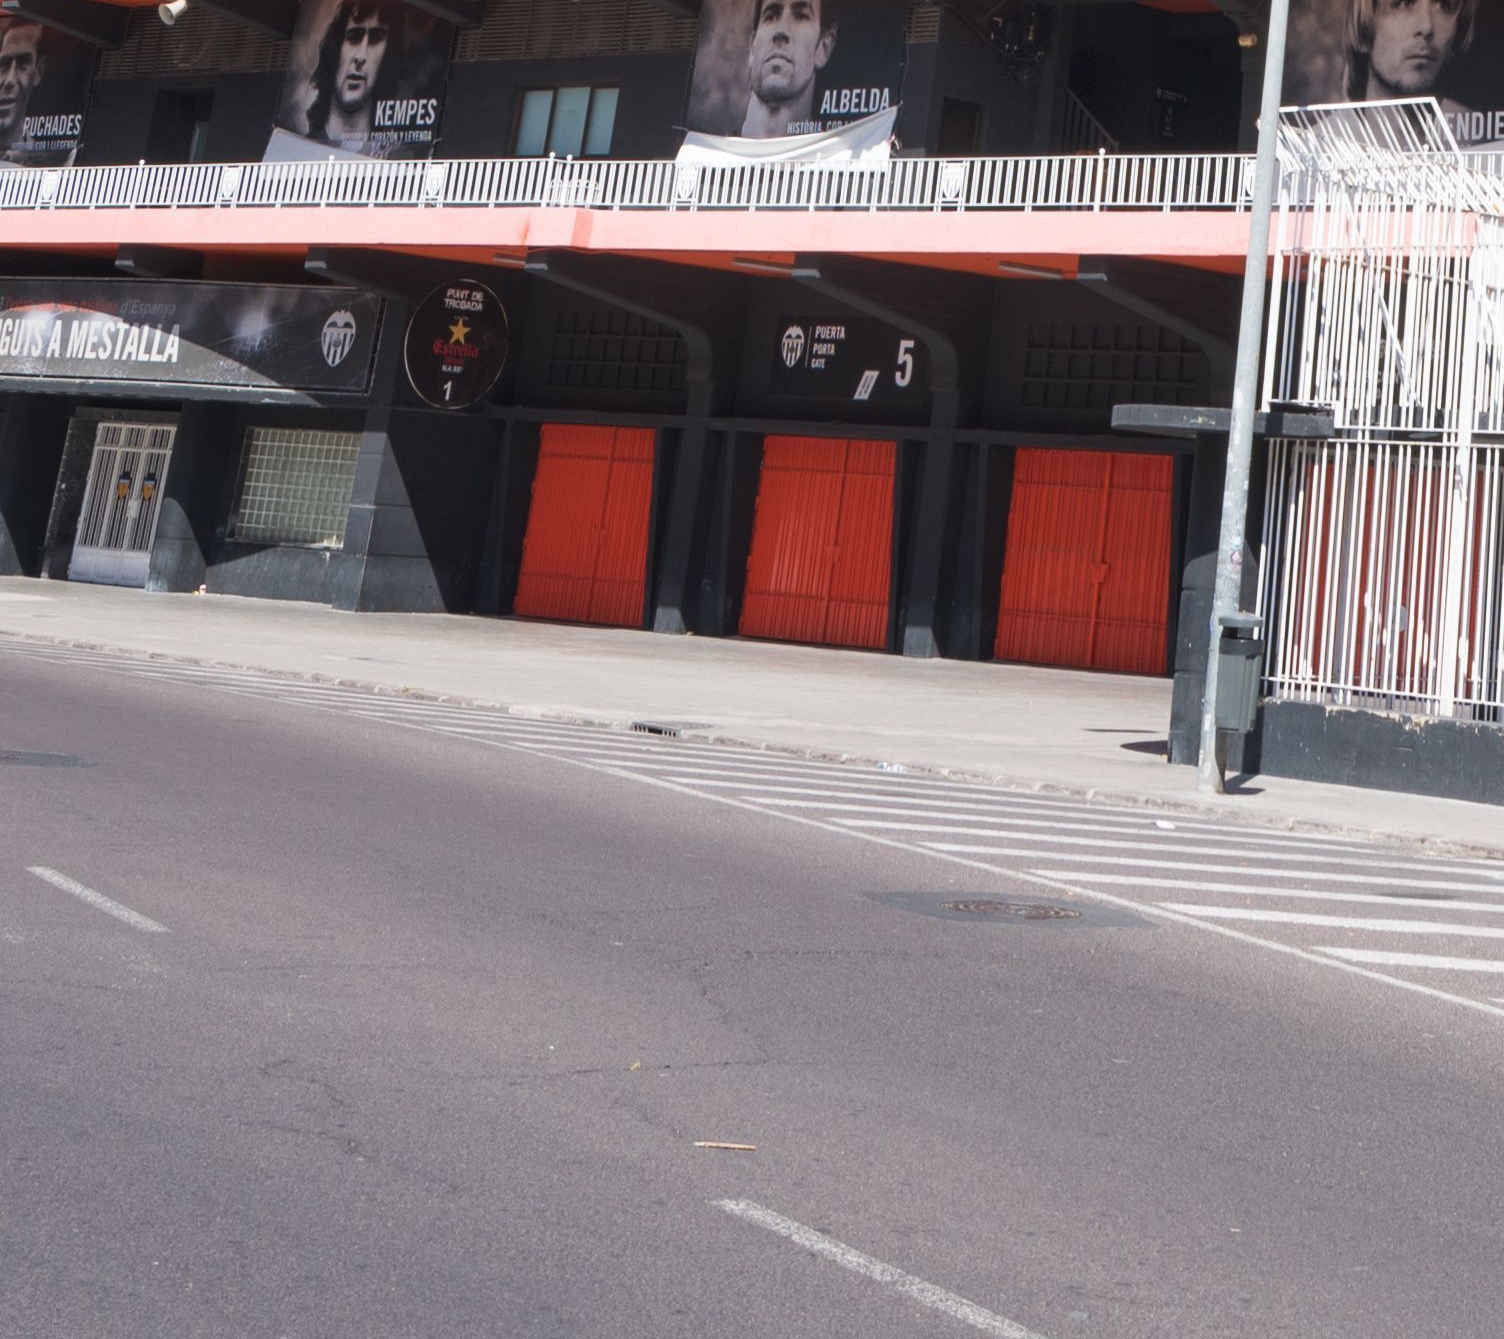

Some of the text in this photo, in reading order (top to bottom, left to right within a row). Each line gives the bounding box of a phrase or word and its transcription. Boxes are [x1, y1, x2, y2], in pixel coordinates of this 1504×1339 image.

[820, 87, 890, 114] ALBELDA
[375, 99, 438, 126] KEMPES
[22, 114, 82, 136] PUCHADES
[405, 130, 432, 142] LEYENDA
[444, 298, 483, 312] TROBADA
[447, 288, 484, 302] PUNT DE
[120, 298, 177, 319] d'Espanya
[47, 320, 62, 359] A
[66, 321, 180, 363] MESTALLA
[815, 326, 845, 339] PUERTA
[811, 358, 825, 368] GATE
[813, 343, 835, 355] PORTA
[895, 339, 914, 387] 5
[443, 380, 453, 401] 1
